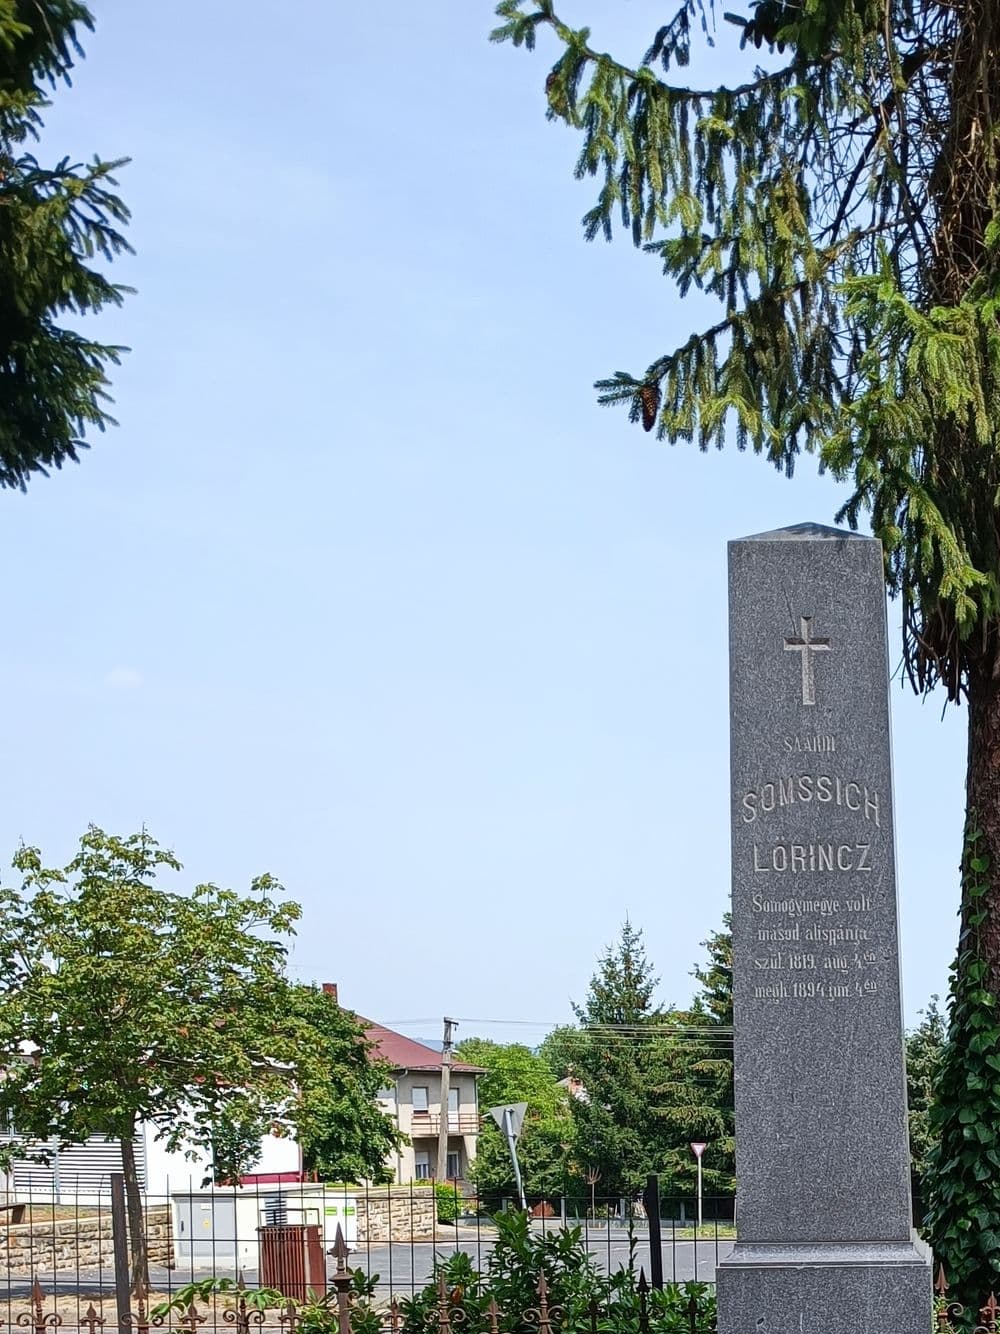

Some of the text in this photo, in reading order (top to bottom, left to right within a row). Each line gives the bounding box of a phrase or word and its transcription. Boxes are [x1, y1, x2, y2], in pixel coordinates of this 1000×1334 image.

[742, 774, 881, 828] SOMSSICH
[752, 894, 873, 917] Somogymegye volt
